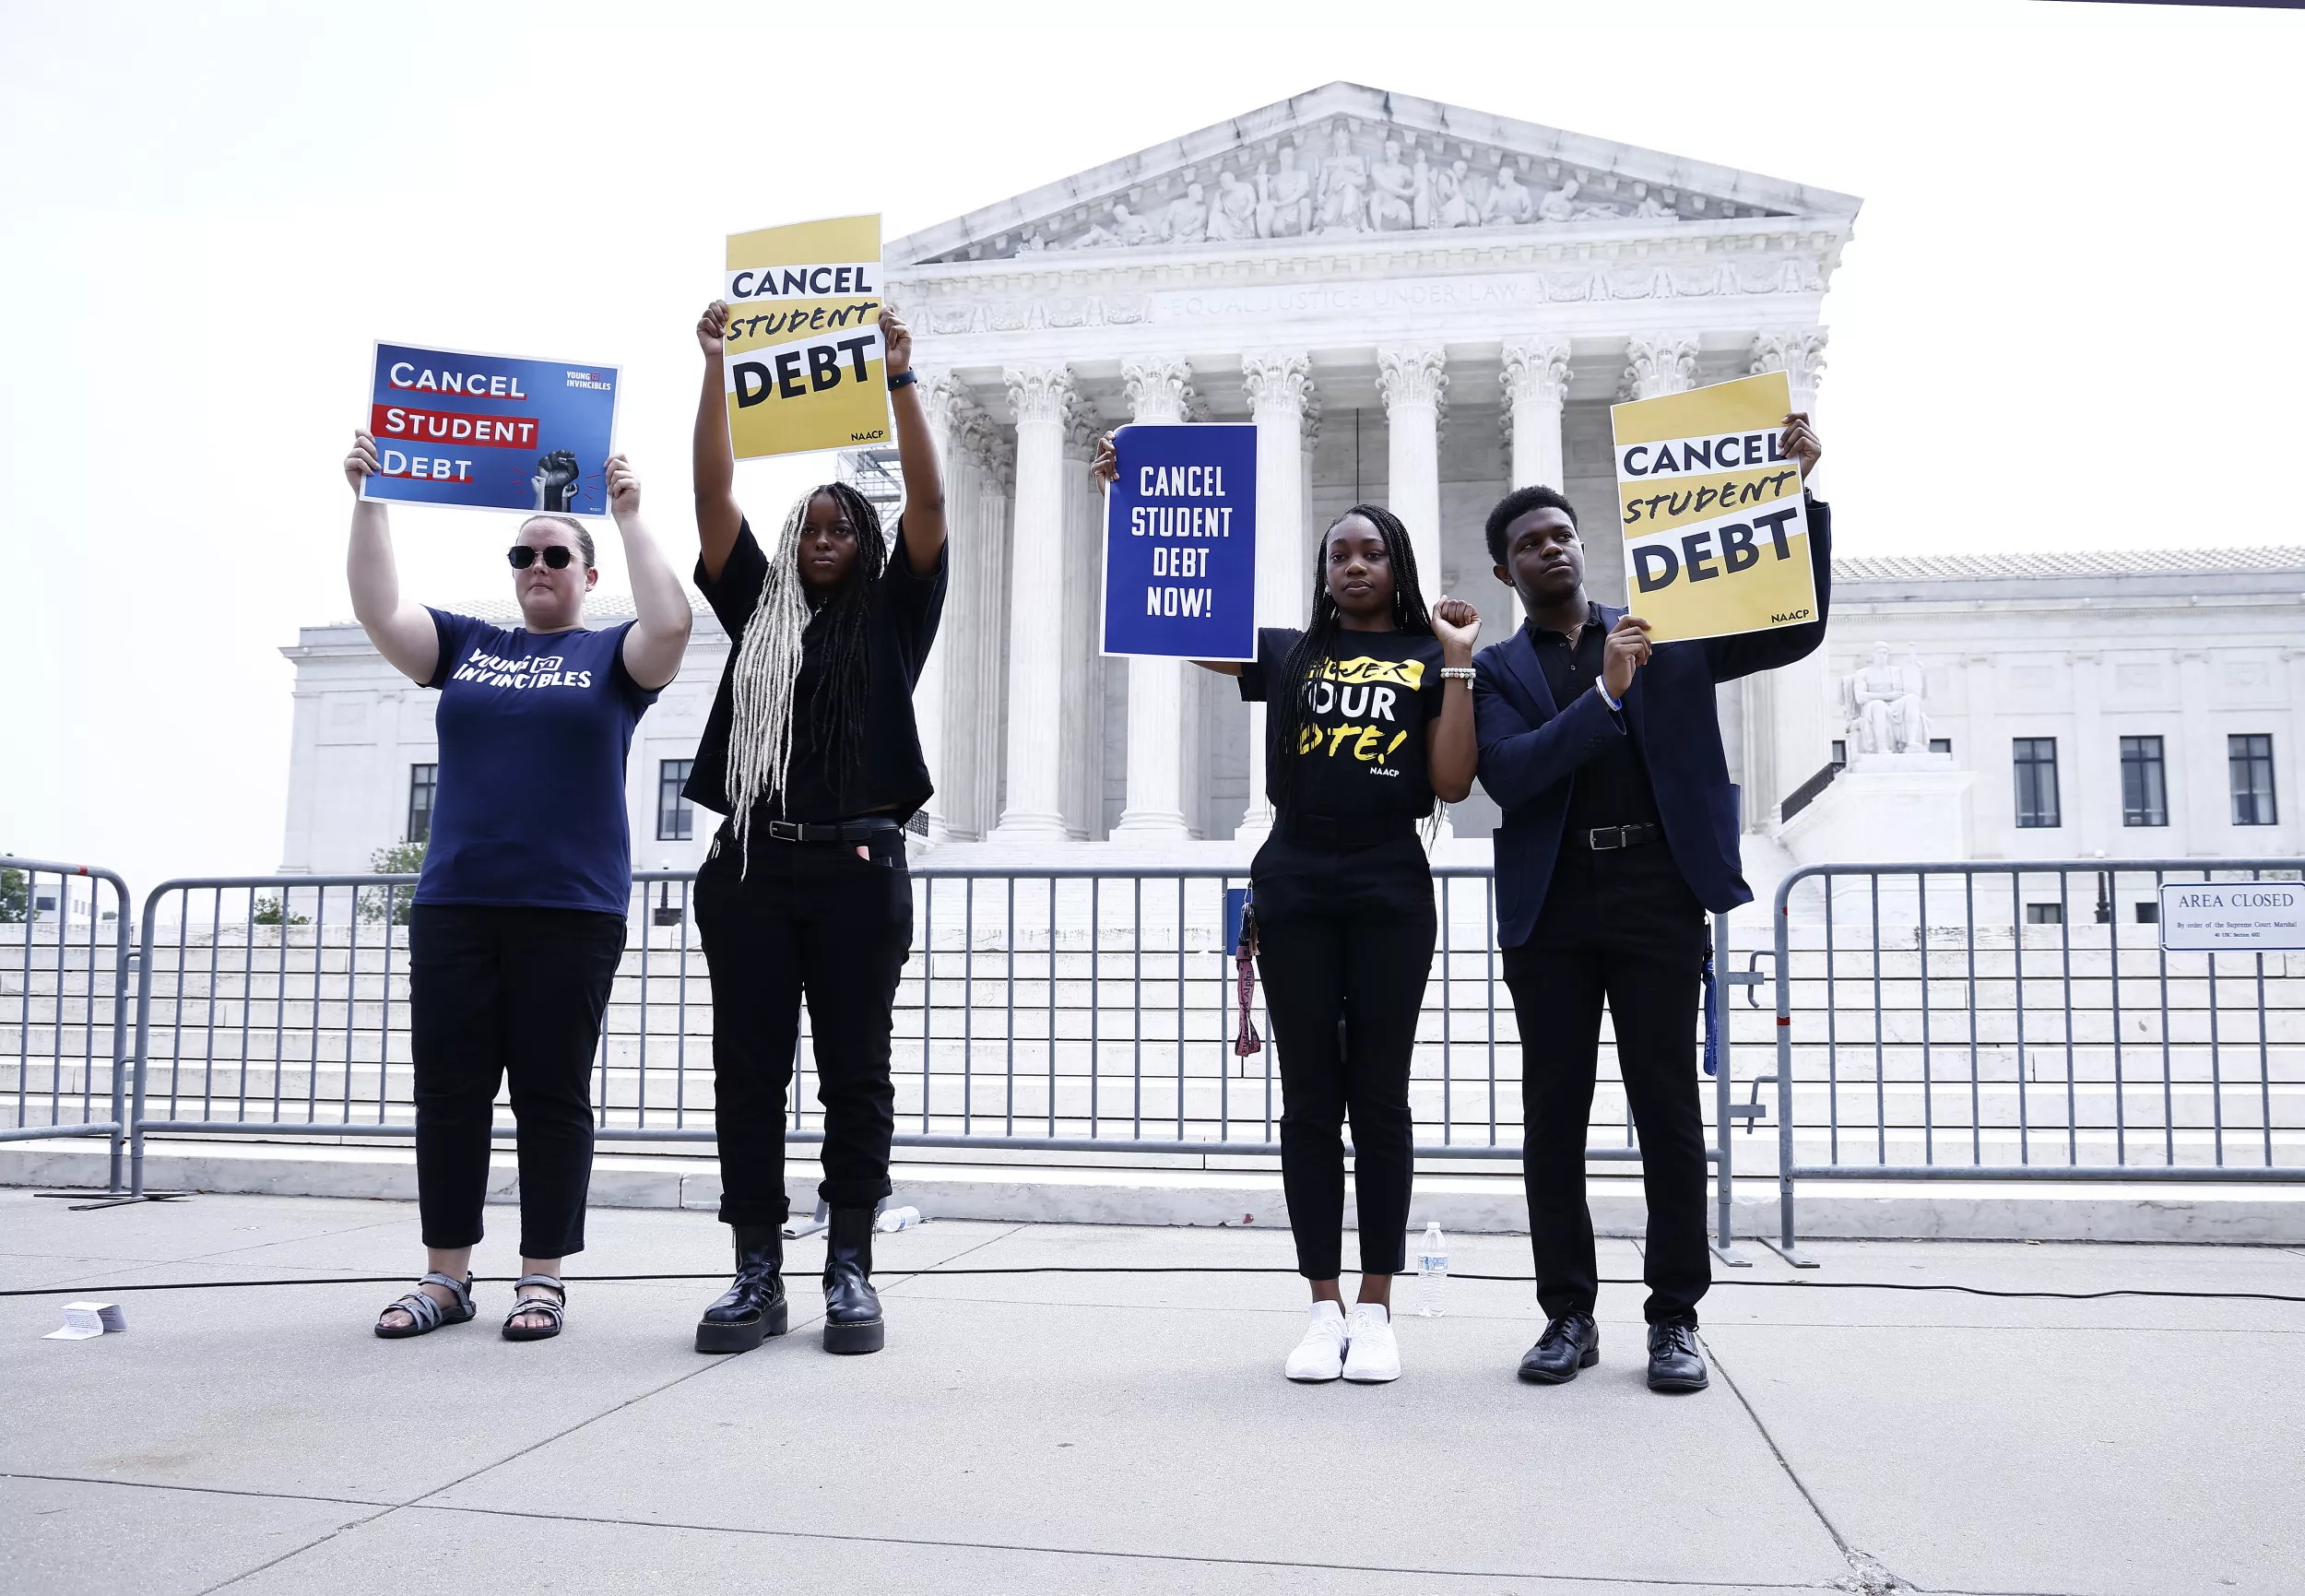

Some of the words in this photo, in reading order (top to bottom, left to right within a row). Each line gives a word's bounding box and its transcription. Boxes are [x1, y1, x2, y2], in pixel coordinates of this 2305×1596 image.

[732, 267, 872, 298] CANCEL
[1171, 295, 1255, 317] EQUAL
[1260, 290, 1359, 311] JUSTICE
[1372, 285, 1454, 307] UNDER
[1469, 282, 1521, 302] LAW
[727, 301, 879, 342] STUDENT
[390, 362, 526, 397] CANCEL
[566, 371, 591, 381] YOUNG
[566, 379, 611, 391] INVINCIBLES
[732, 335, 876, 408] DEBT
[385, 408, 535, 443] STUDENT
[851, 430, 884, 442] NAACP
[383, 450, 472, 480] DEBT
[1624, 433, 1790, 476] CANCEL
[1140, 466, 1226, 497] CANCEL
[1623, 470, 1797, 525] STUDENT
[1131, 506, 1233, 538] STUDENT
[1152, 547, 1210, 578] DEBT
[1631, 507, 1798, 594] DEBT
[1147, 586, 1212, 618] NOW!
[1771, 609, 1810, 623] NAACP
[468, 647, 532, 673] YOUNG
[452, 663, 592, 690] INVINCIBLES
[1302, 680, 1396, 722] OUR
[1299, 722, 1408, 764] OTE!
[1370, 766, 1400, 778] NAACP
[2179, 893, 2224, 907] AREA
[2231, 893, 2294, 907] CLOSED
[2227, 921, 2252, 929] Supreme
[1243, 970, 1254, 999] Alpha
